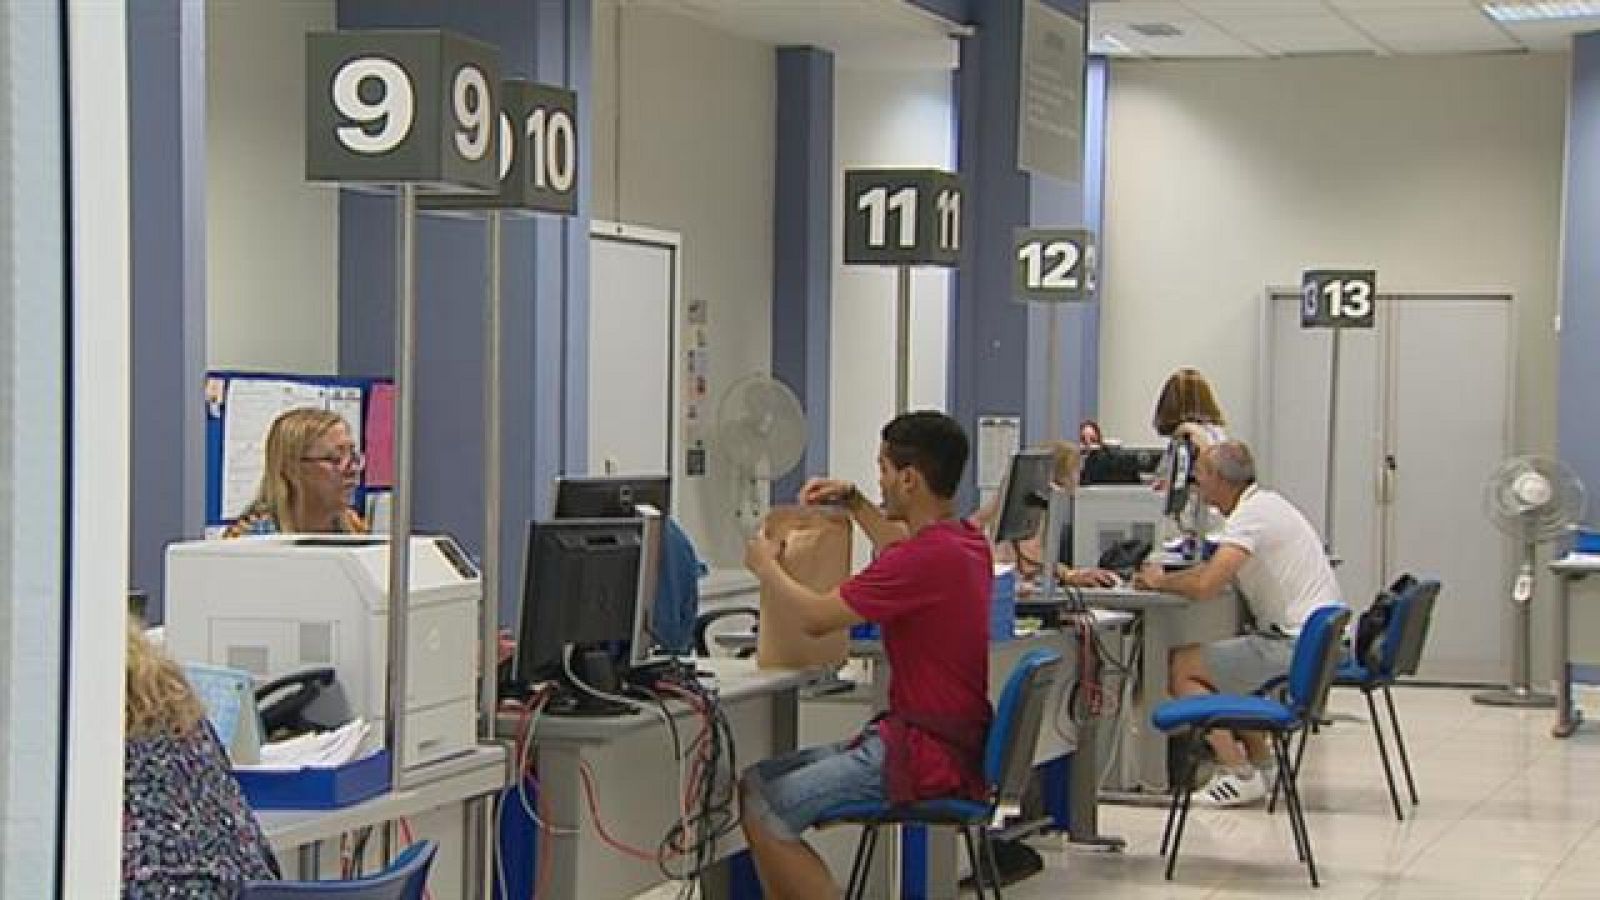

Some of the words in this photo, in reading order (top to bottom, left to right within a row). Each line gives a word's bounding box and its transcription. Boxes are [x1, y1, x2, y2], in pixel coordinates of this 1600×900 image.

[332, 57, 414, 154] 9
[453, 65, 491, 161] 9
[526, 107, 575, 191] 10
[859, 187, 917, 246] 11
[936, 189, 961, 250] 11
[1019, 241, 1079, 289] 12
[1324, 279, 1371, 316] 13
